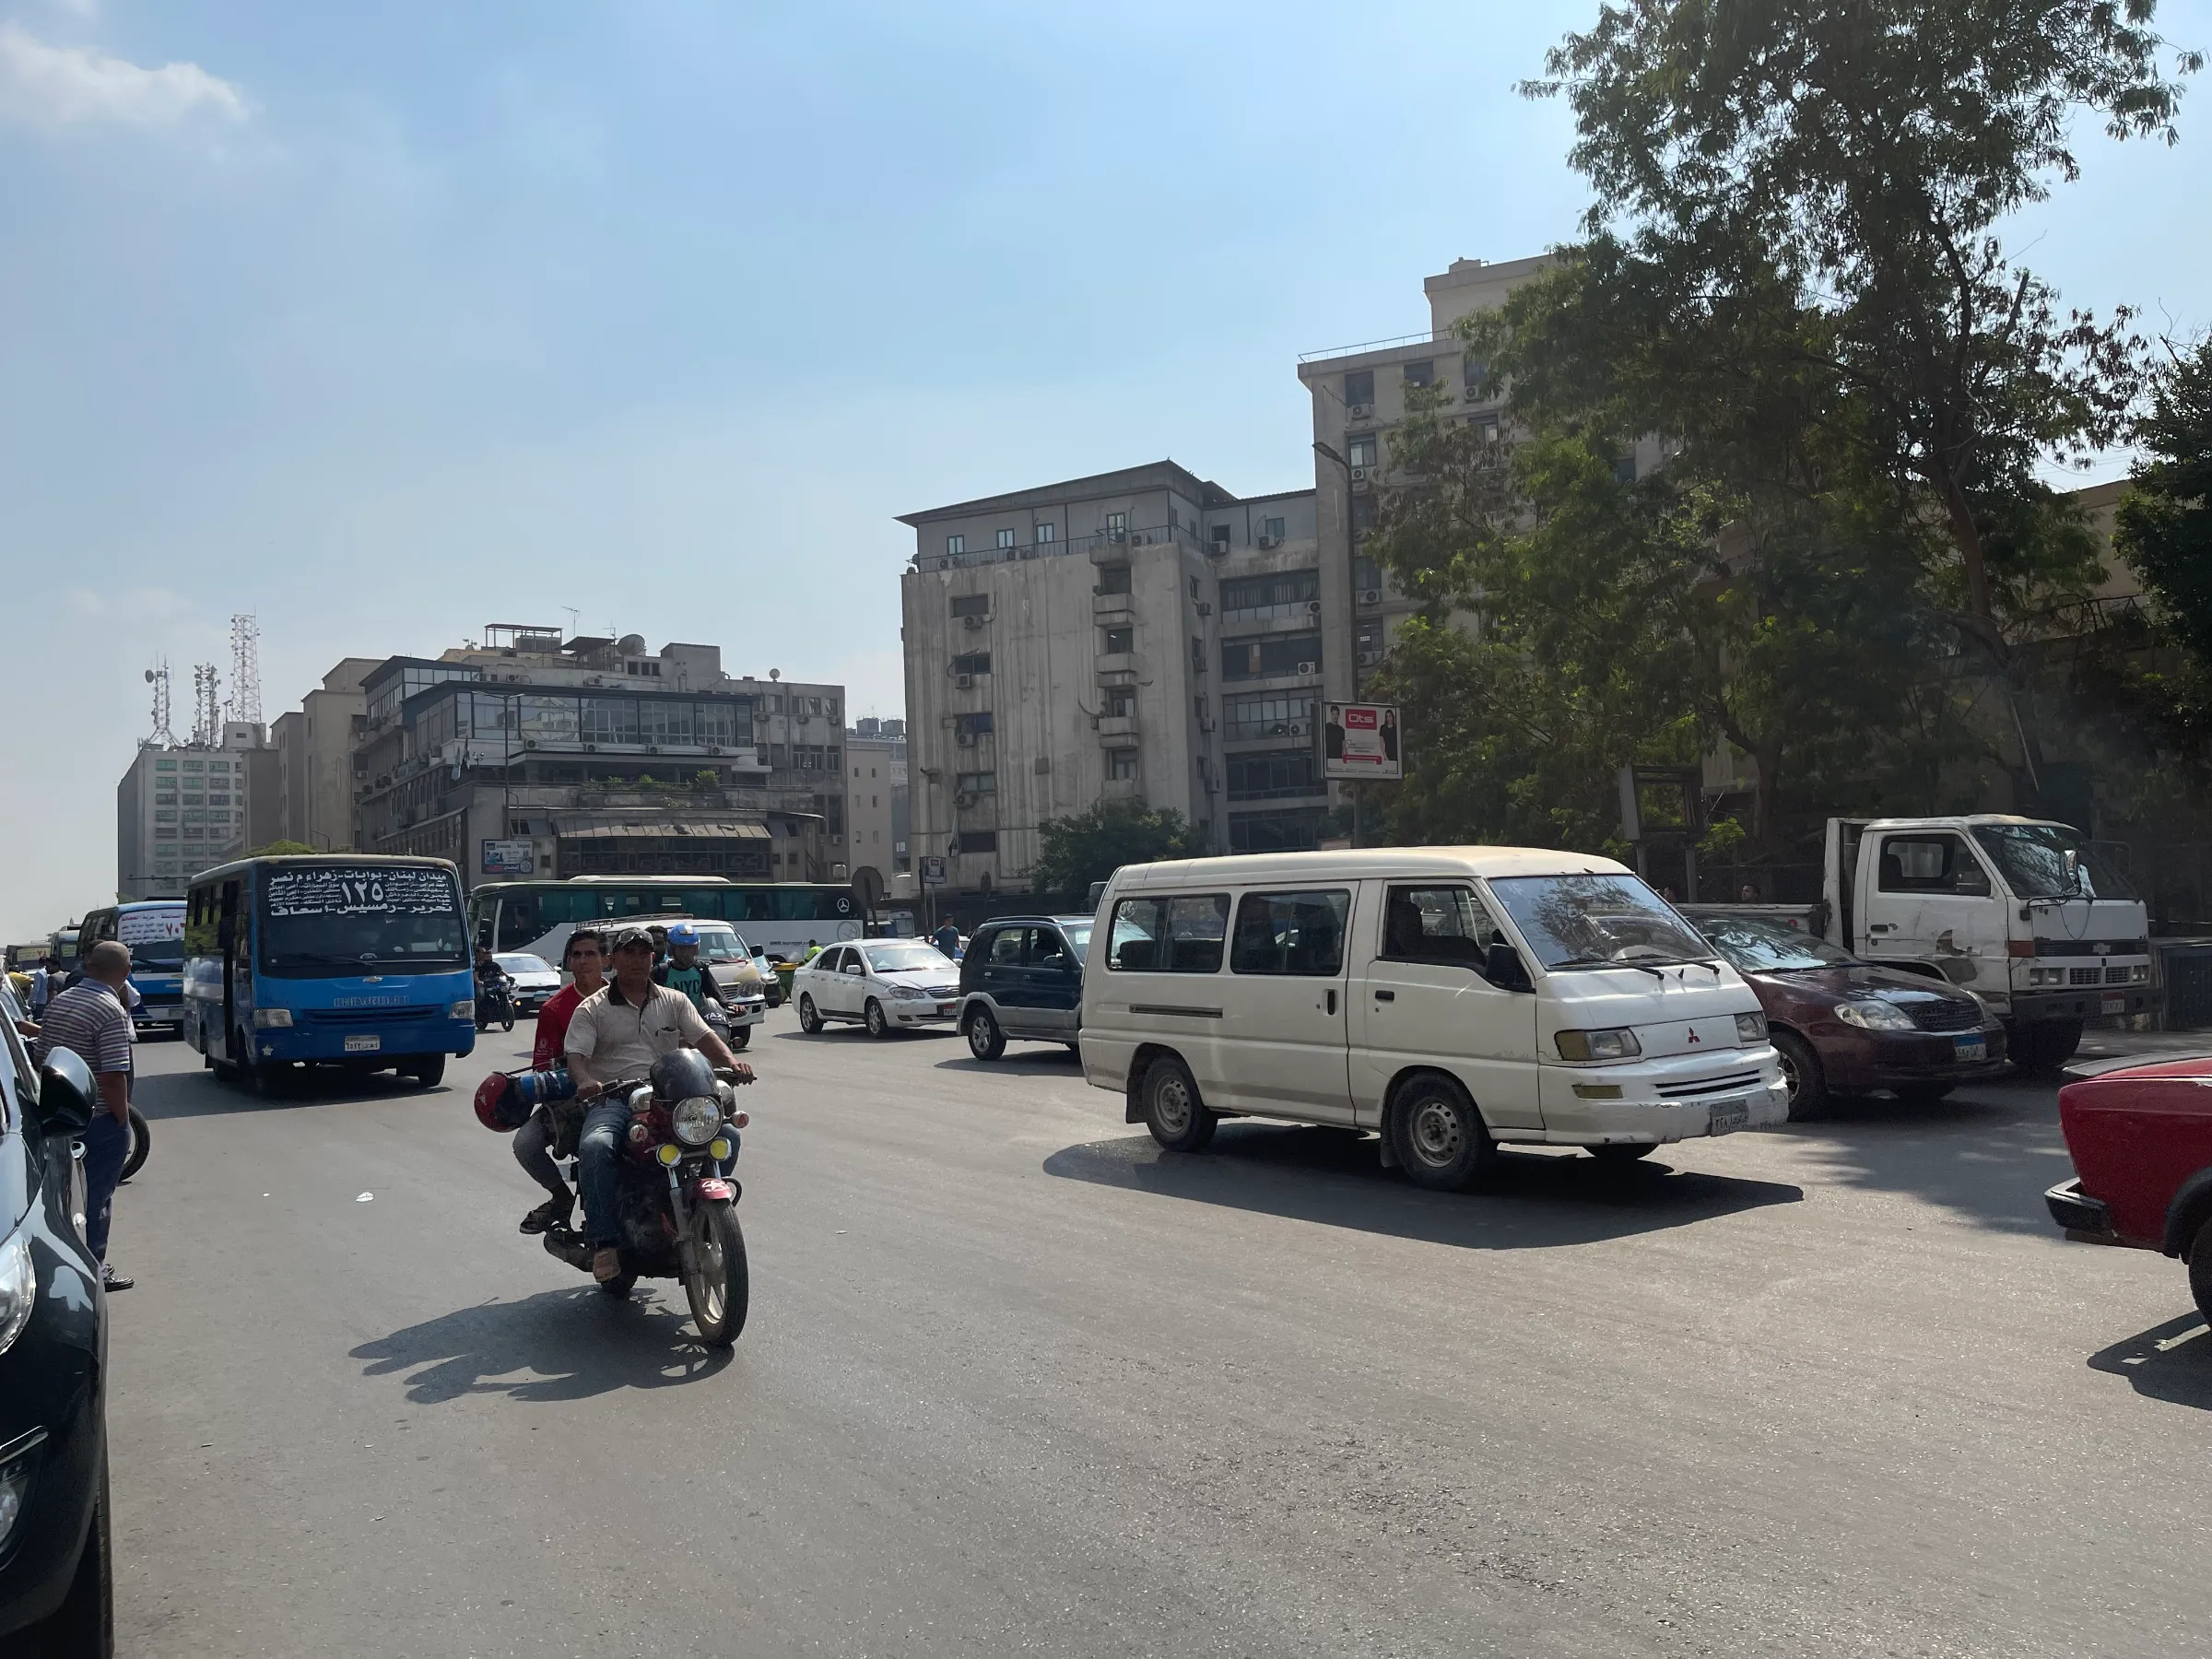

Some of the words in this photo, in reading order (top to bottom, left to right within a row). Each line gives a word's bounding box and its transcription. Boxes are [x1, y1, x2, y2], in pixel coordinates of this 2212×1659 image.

[269, 872, 294, 886] نصر
[418, 871, 447, 883] ميدان
[341, 881, 384, 904] ١٢٥
[408, 903, 453, 913] تحرير
[673, 979, 700, 995] NYC
[703, 1011, 727, 1023] TAXI
